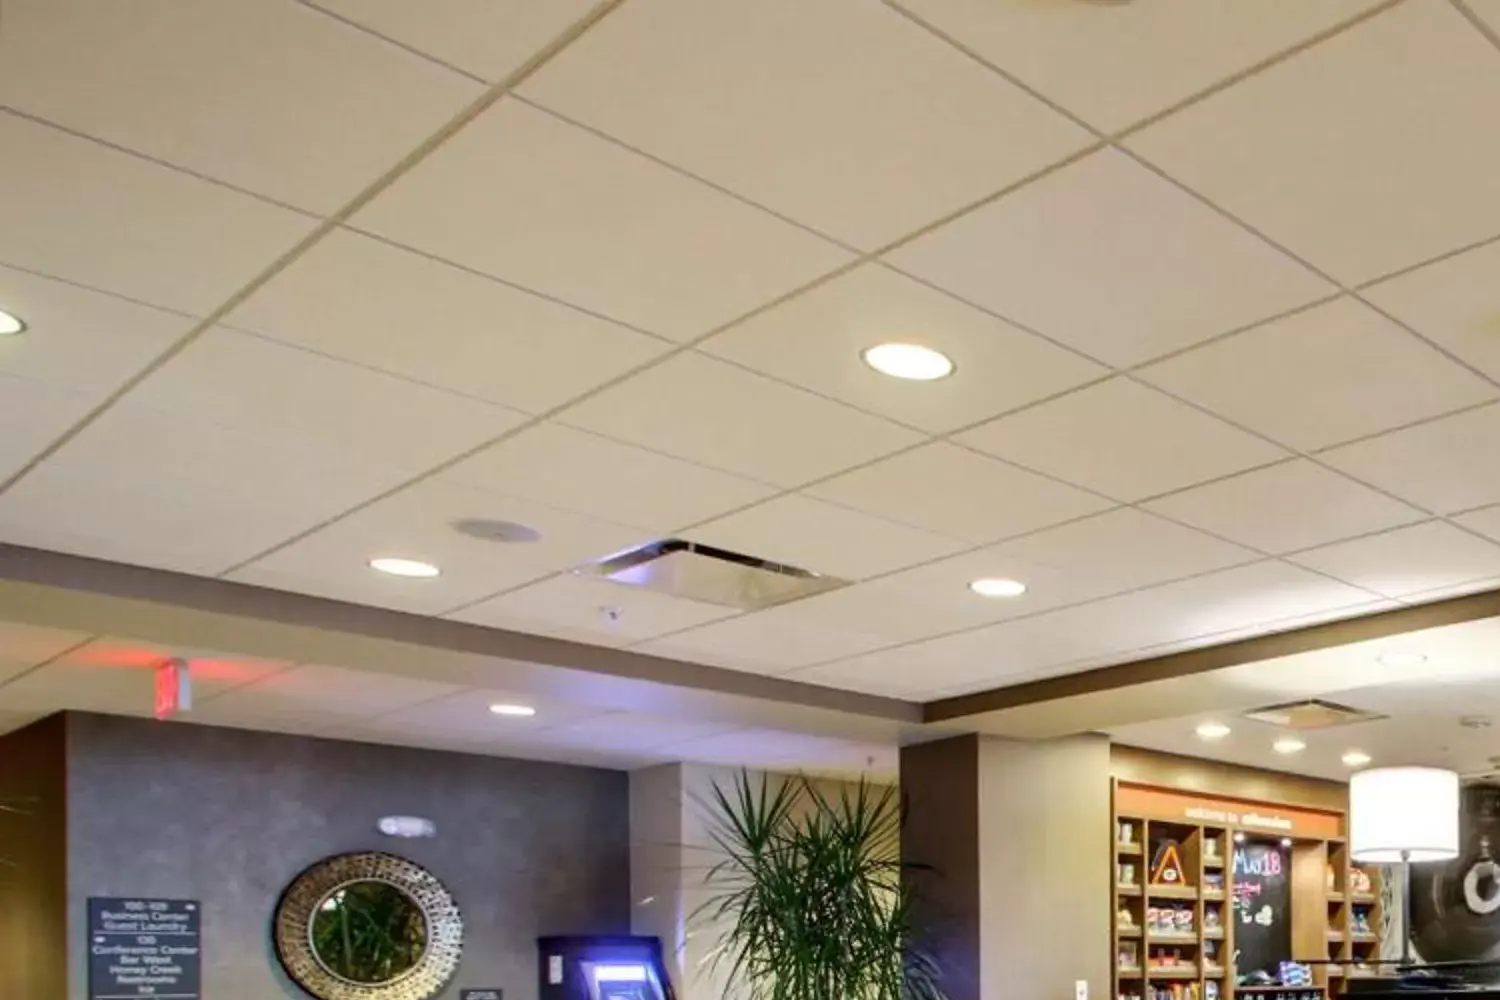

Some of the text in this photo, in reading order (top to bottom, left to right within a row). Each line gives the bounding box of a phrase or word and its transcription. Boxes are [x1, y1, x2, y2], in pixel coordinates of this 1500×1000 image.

[101, 911, 190, 921] Business Center
[103, 921, 188, 932] Guest Laundry
[92, 945, 197, 955] Conference Center
